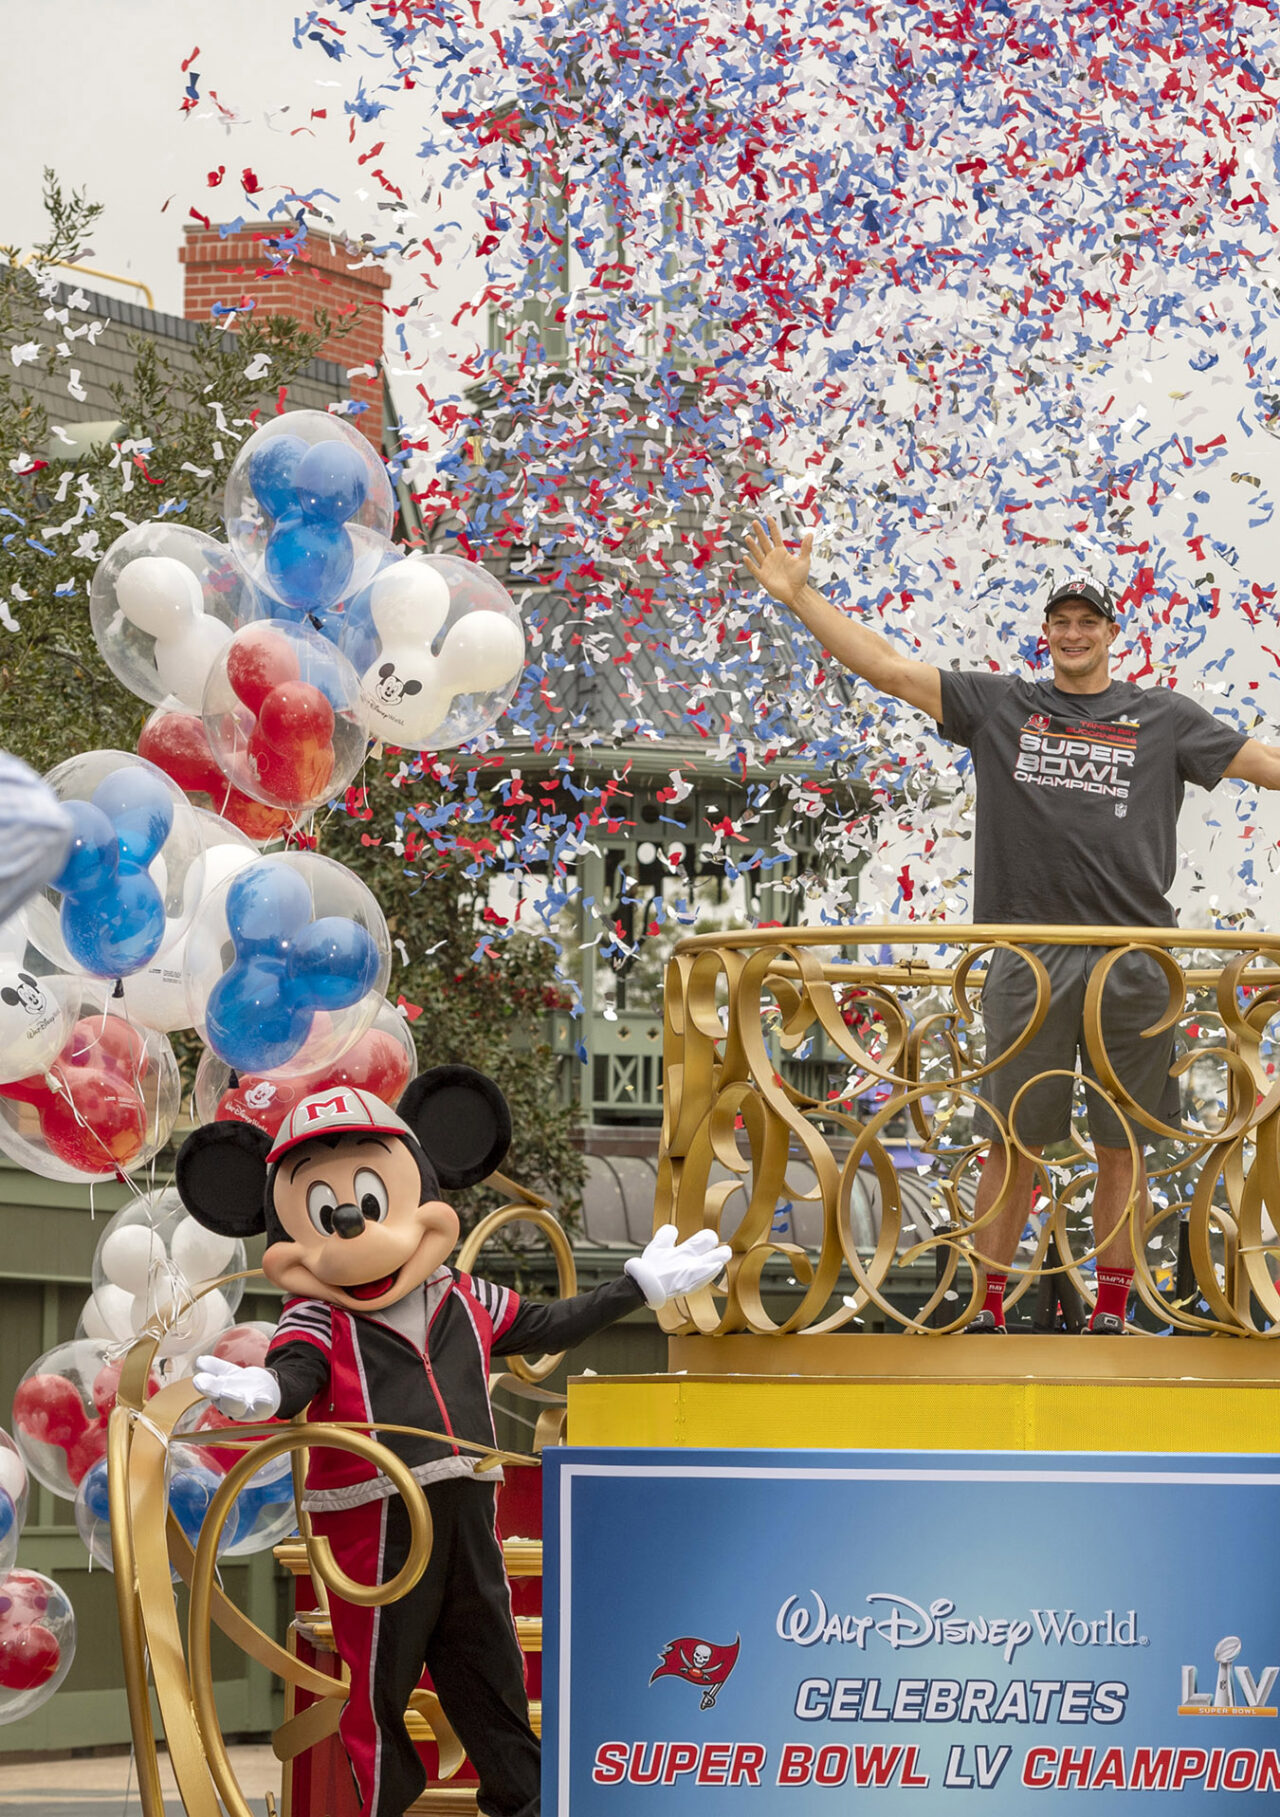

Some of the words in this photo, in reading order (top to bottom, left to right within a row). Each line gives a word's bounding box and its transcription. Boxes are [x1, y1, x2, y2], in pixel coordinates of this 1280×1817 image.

[1019, 733, 1136, 768] SUPER
[1013, 770, 1129, 799] CHAMPIONS
[1015, 751, 1131, 788] BOWL
[300, 1093, 354, 1125] M
[776, 1589, 874, 1648] Walt
[866, 1592, 1034, 1664] Disney
[794, 1678, 1129, 1725] CELEBRATES
[1198, 1707, 1229, 1715] SUPER
[1231, 1708, 1257, 1716] BOWL
[592, 1741, 766, 1787] SUPER
[776, 1743, 930, 1788] BOWL
[943, 1745, 1013, 1790] LV
